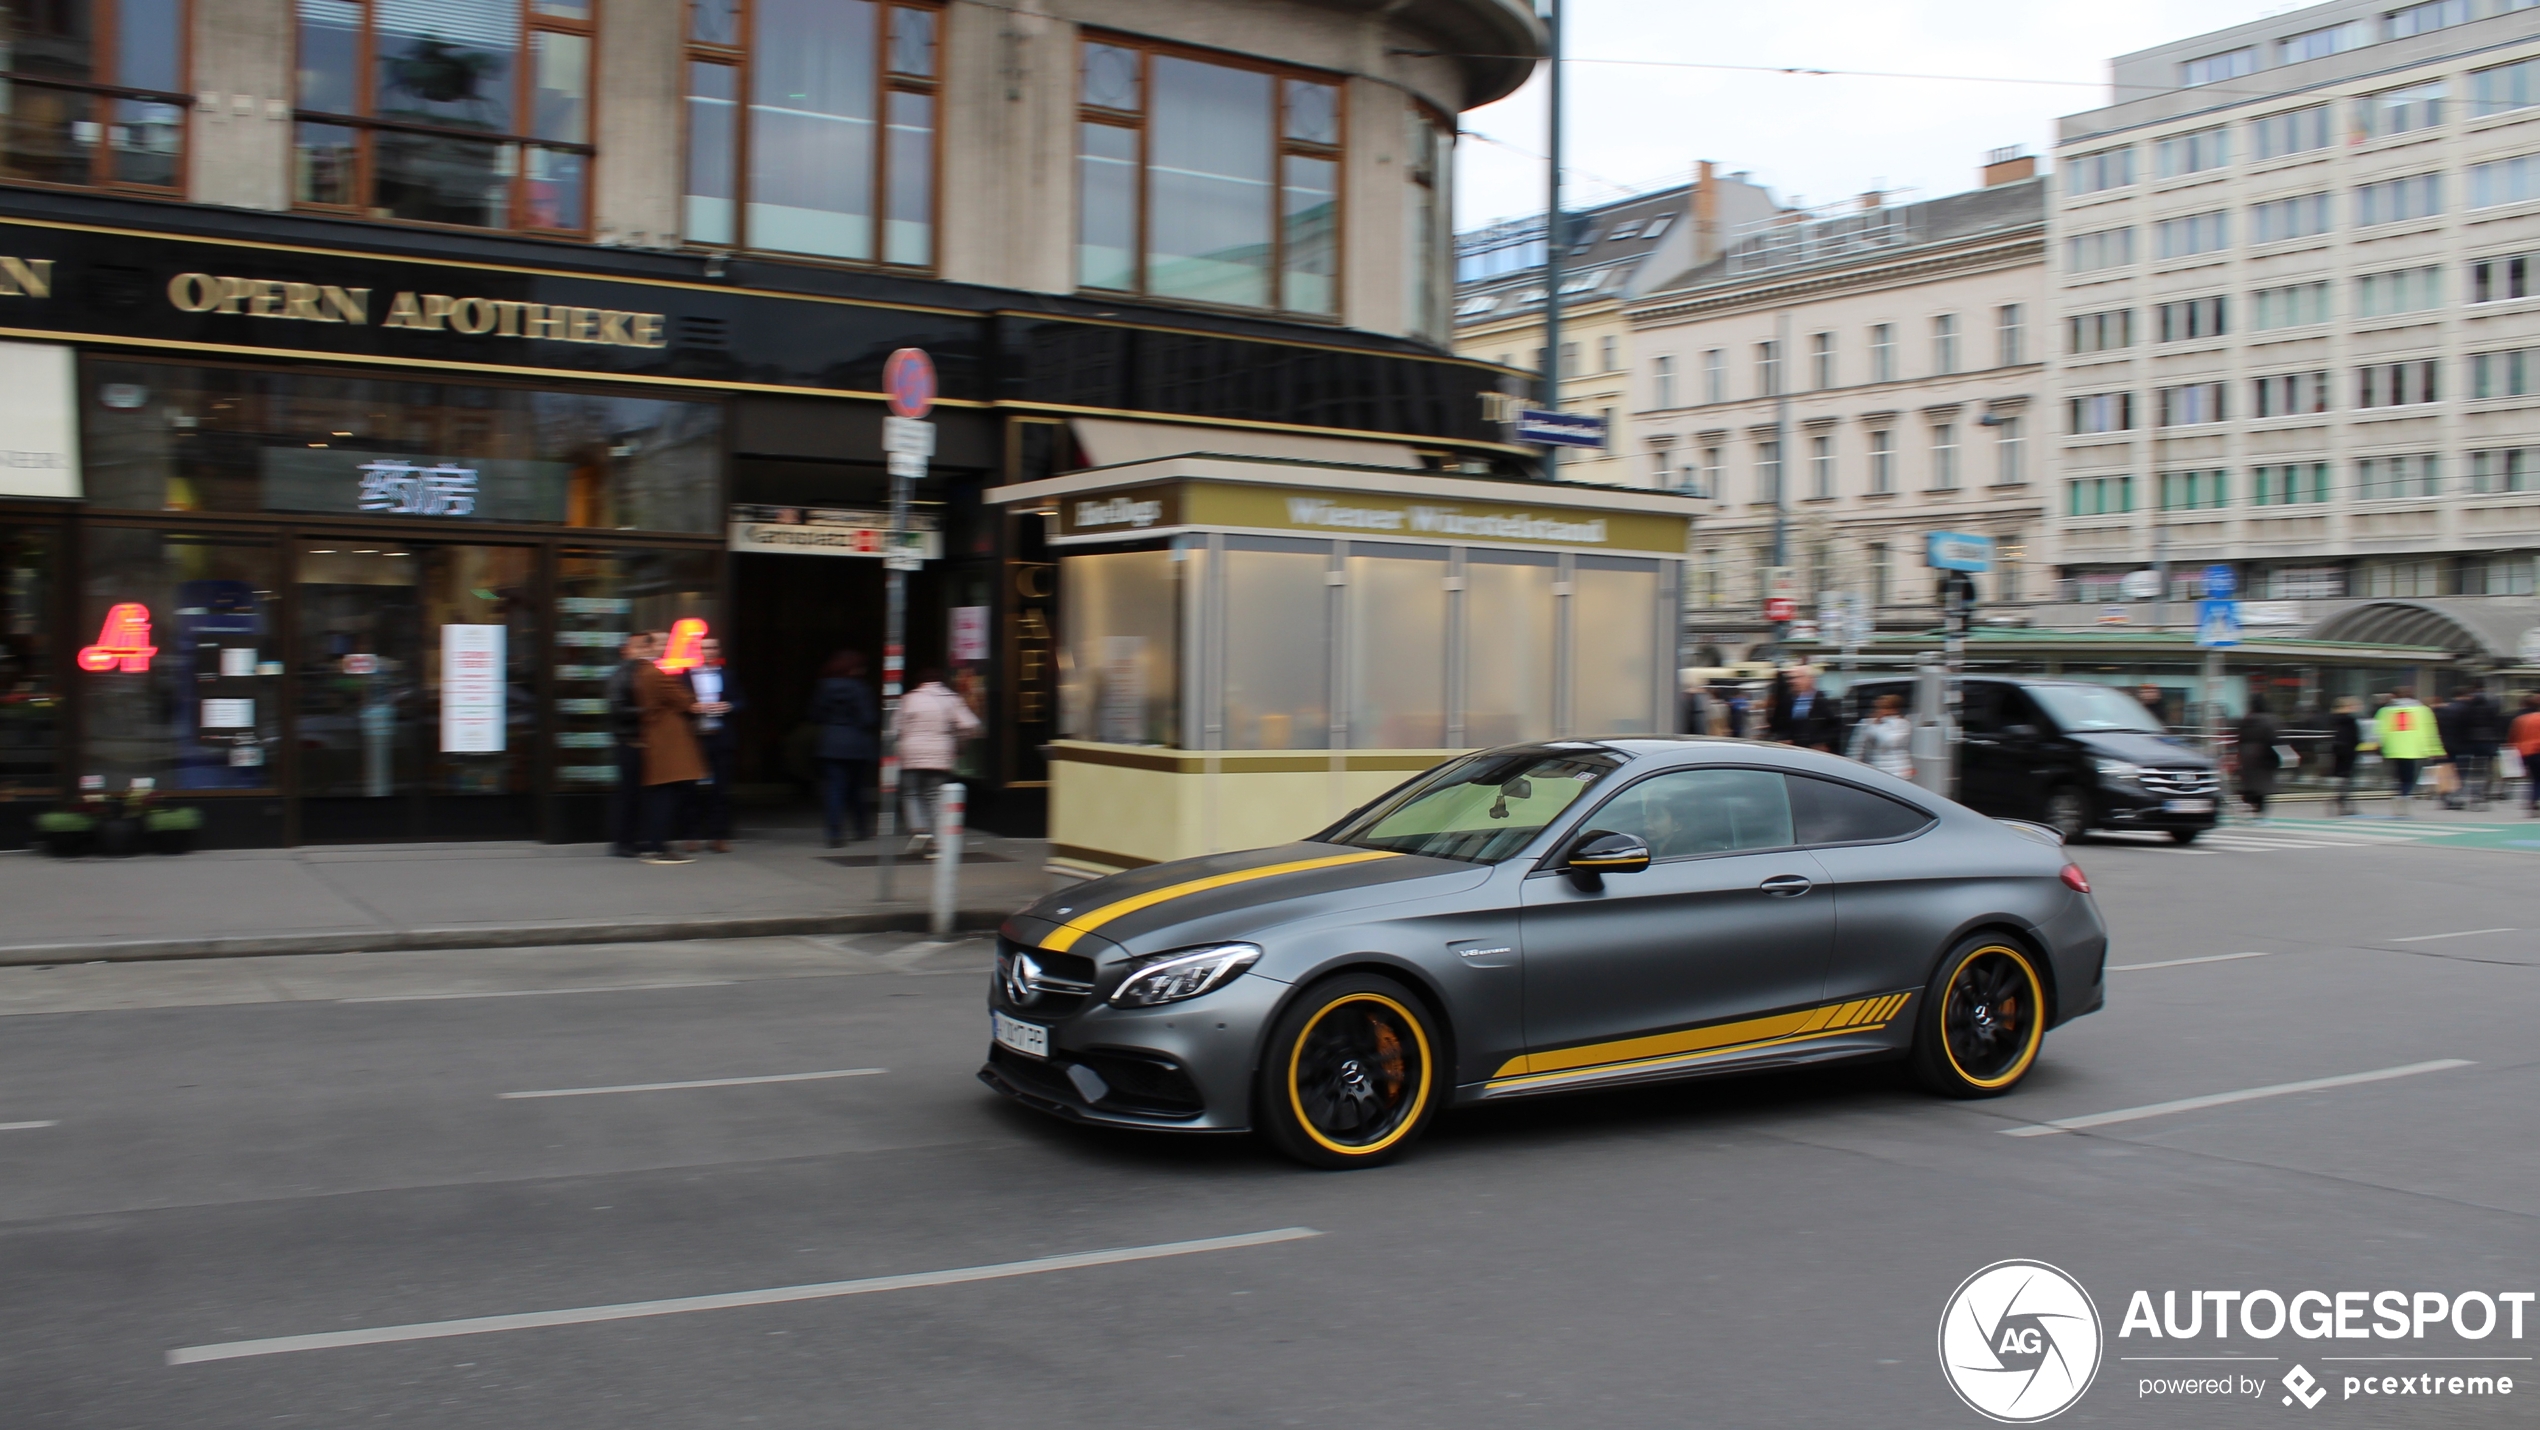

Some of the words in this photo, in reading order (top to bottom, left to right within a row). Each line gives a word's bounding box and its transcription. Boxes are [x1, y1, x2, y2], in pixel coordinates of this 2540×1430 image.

[167, 273, 373, 325] OPERN
[380, 291, 668, 348] APOTHEKE
[1287, 497, 1404, 529] Wiener
[1405, 505, 1608, 542] Würstelstand
